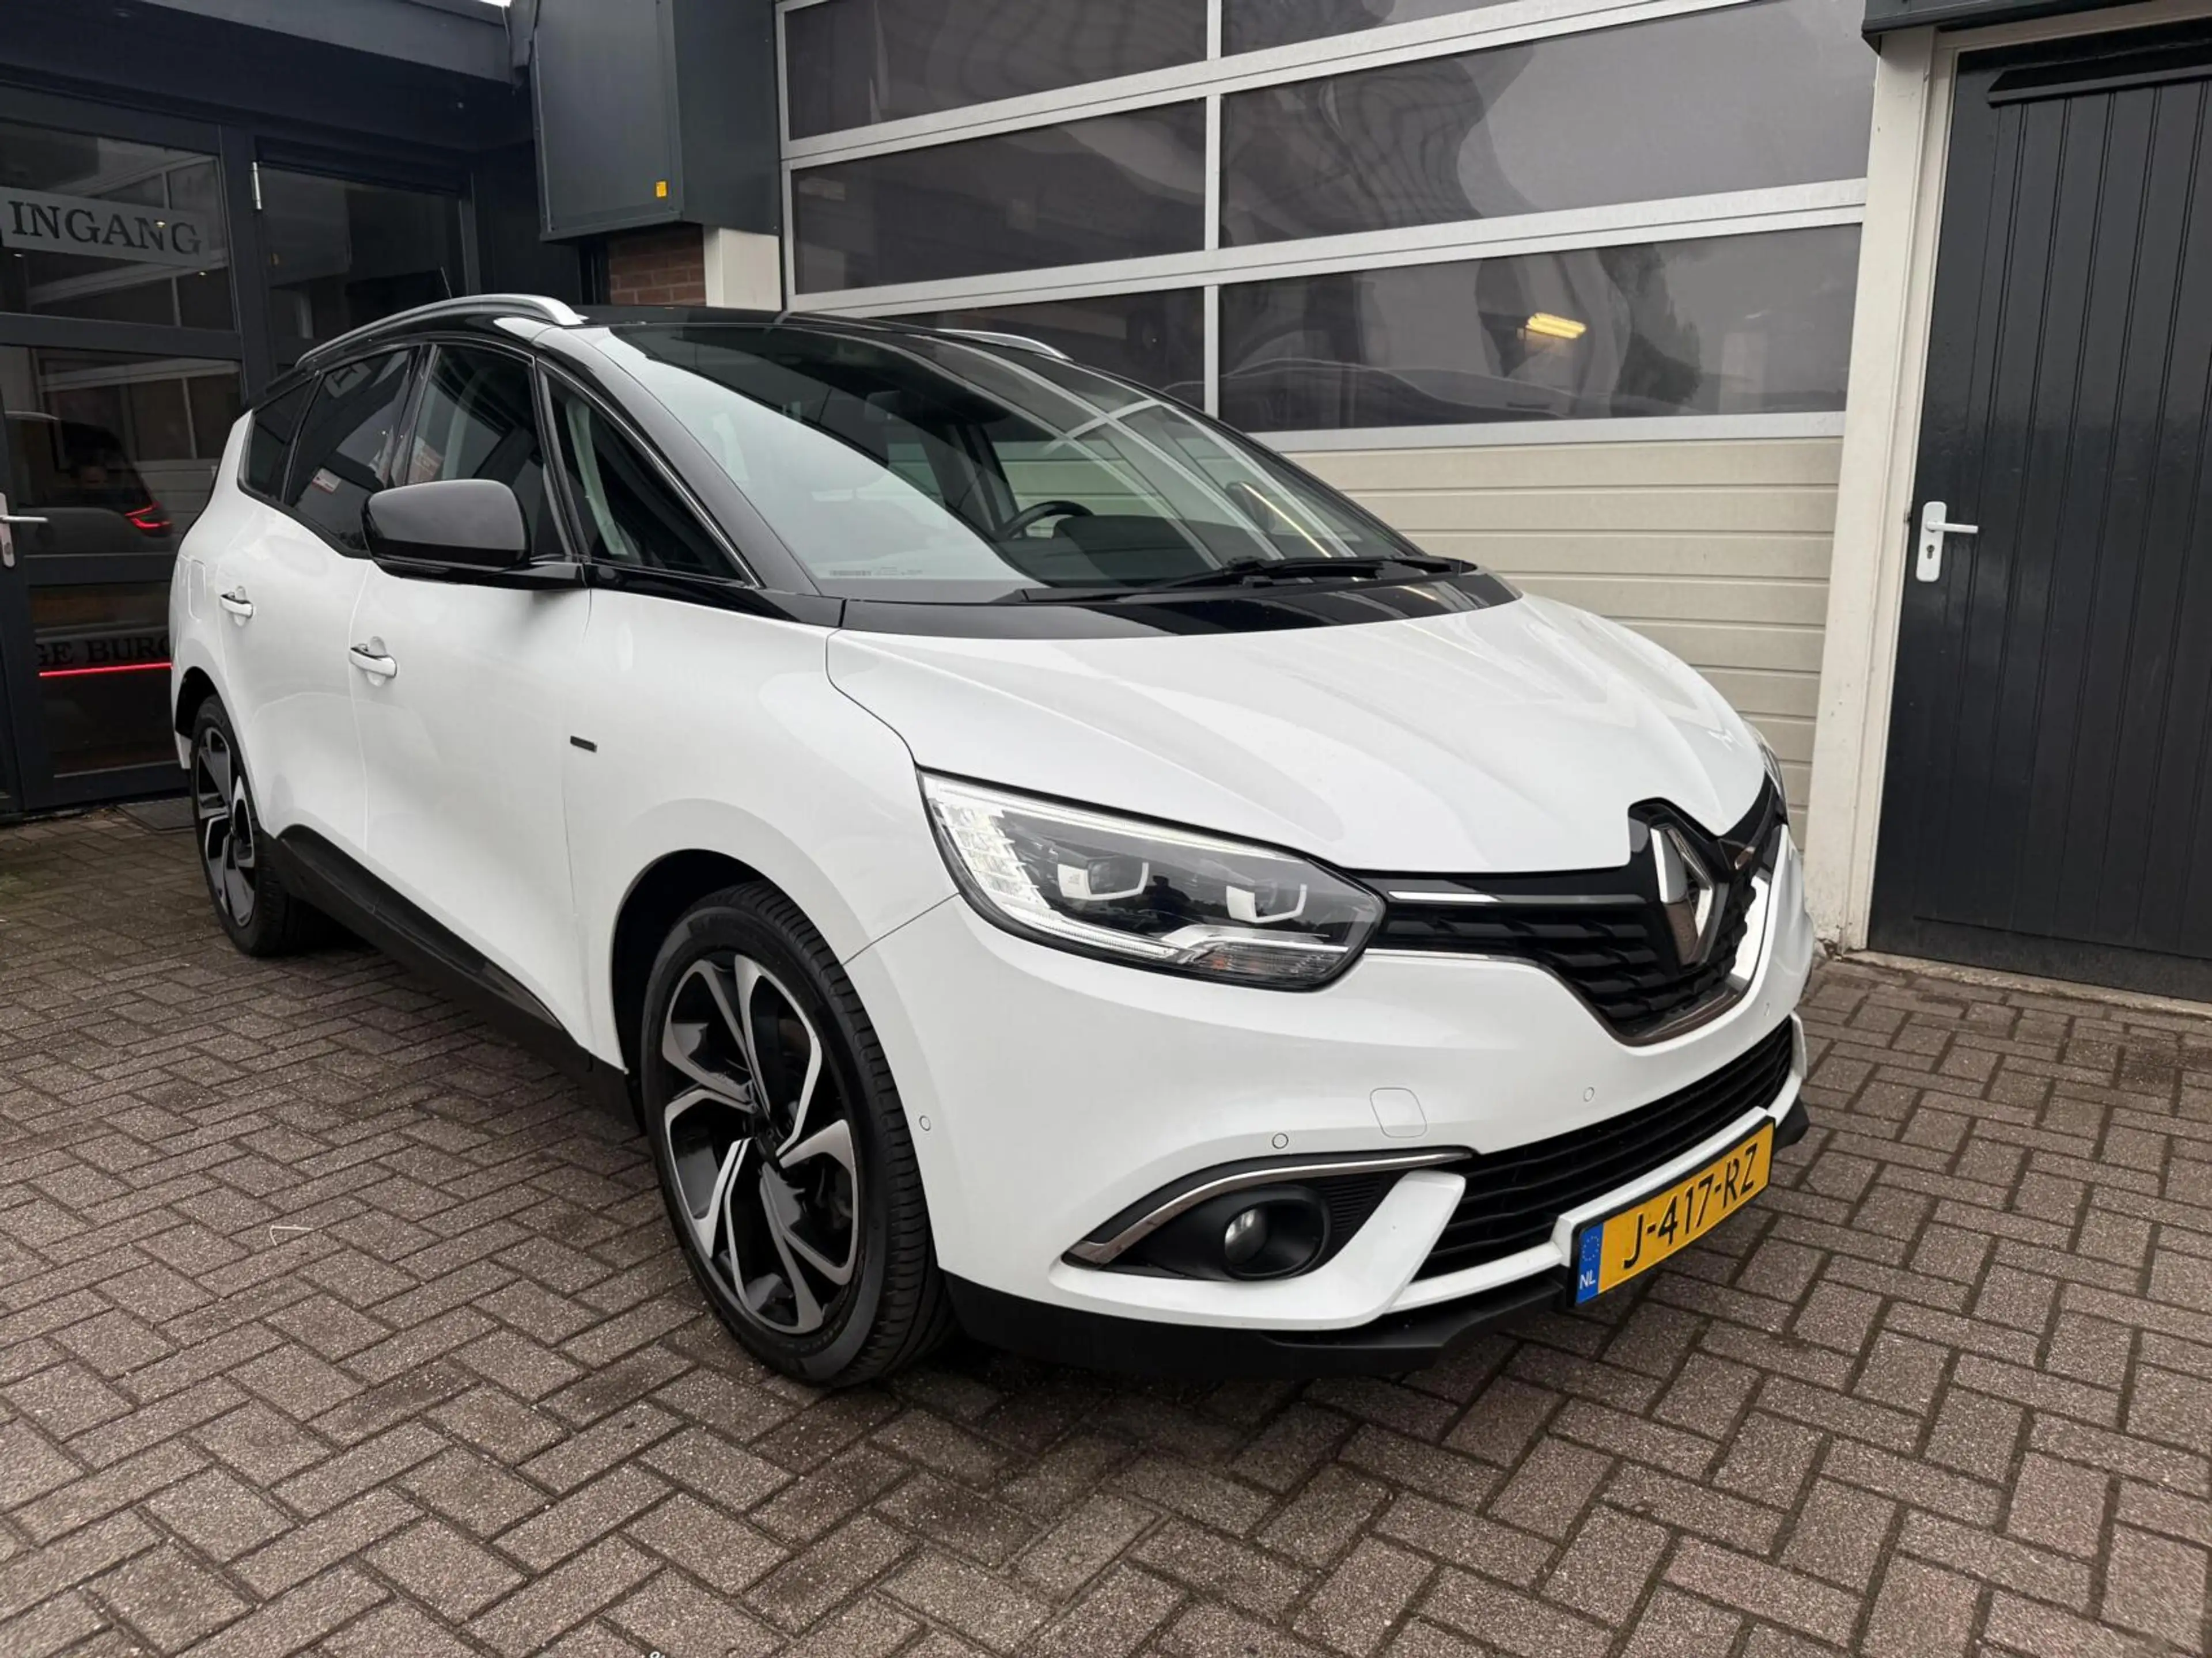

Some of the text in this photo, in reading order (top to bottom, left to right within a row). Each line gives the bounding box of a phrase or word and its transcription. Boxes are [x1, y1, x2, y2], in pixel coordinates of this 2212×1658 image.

[8, 200, 202, 255] INGANG
[1622, 1142, 1758, 1270] J-417-RZ
[1579, 1269, 1596, 1289] NL
